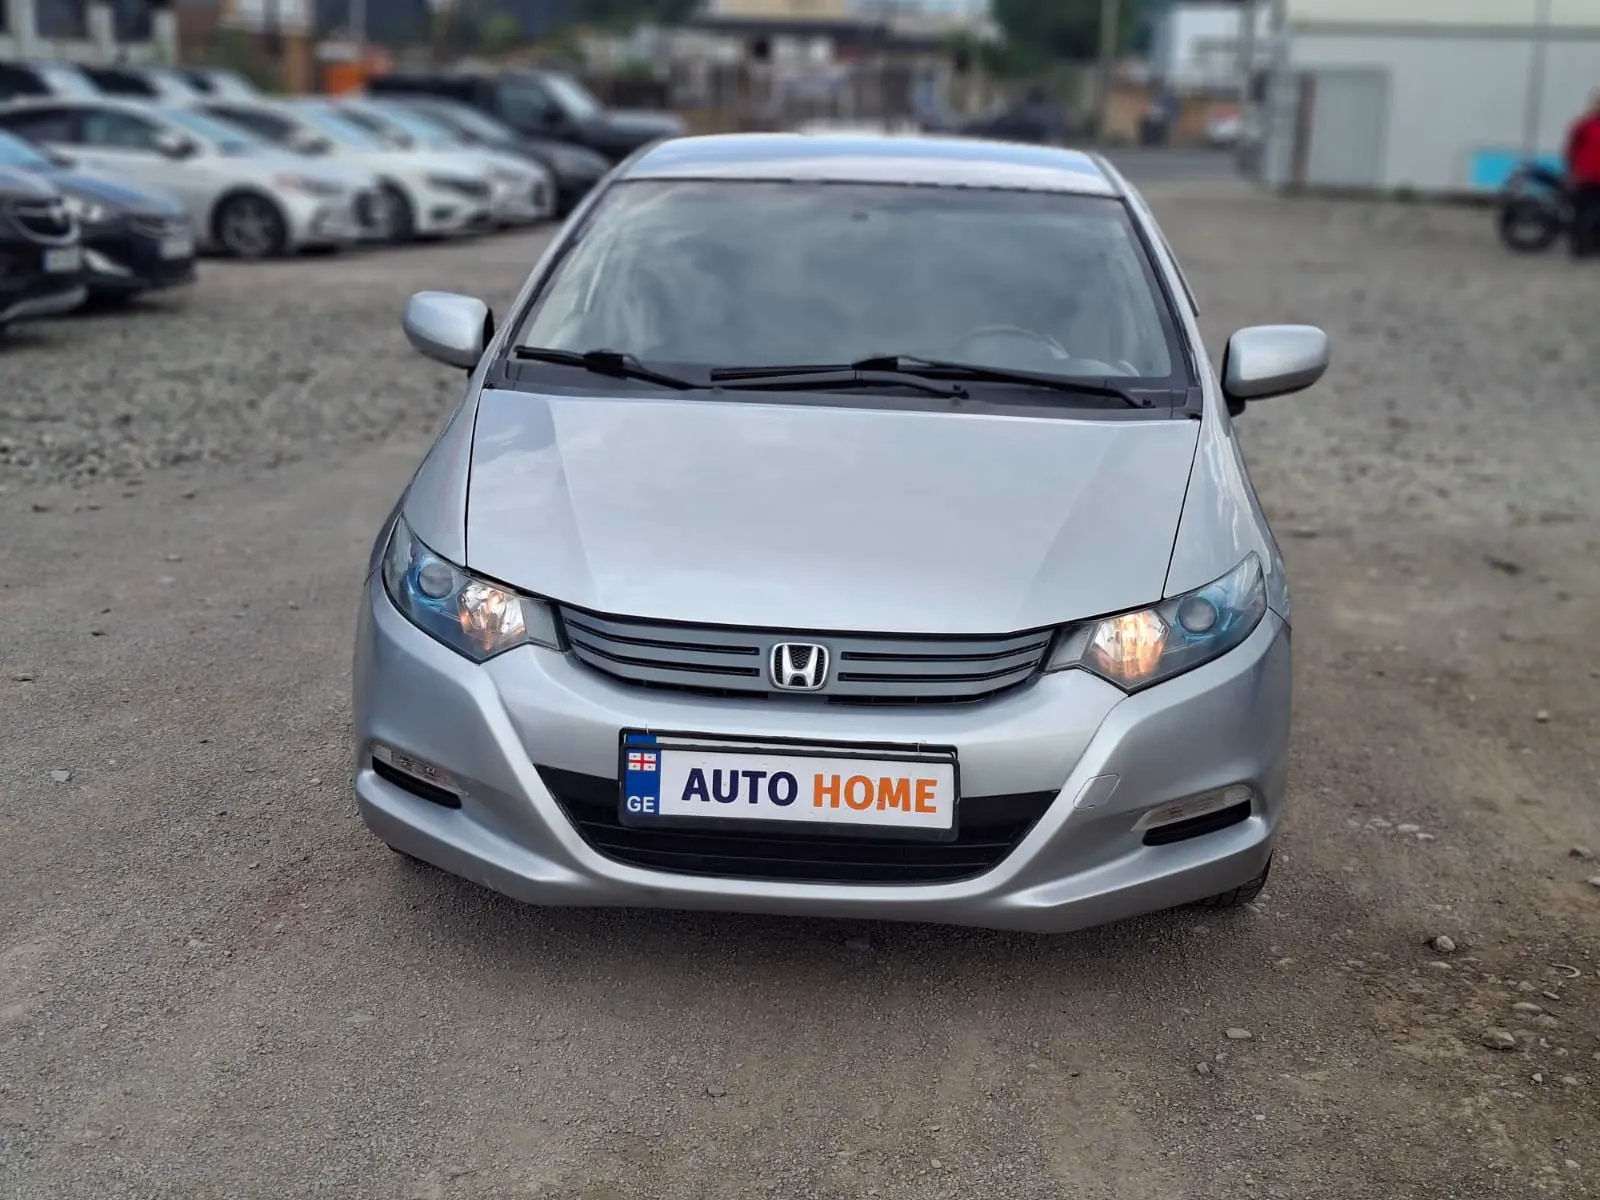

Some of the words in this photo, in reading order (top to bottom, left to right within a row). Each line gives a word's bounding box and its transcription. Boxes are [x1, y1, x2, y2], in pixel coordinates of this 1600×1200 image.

[627, 795, 655, 813] GE
[681, 767, 798, 807] AUTO
[813, 773, 938, 813] HOME
